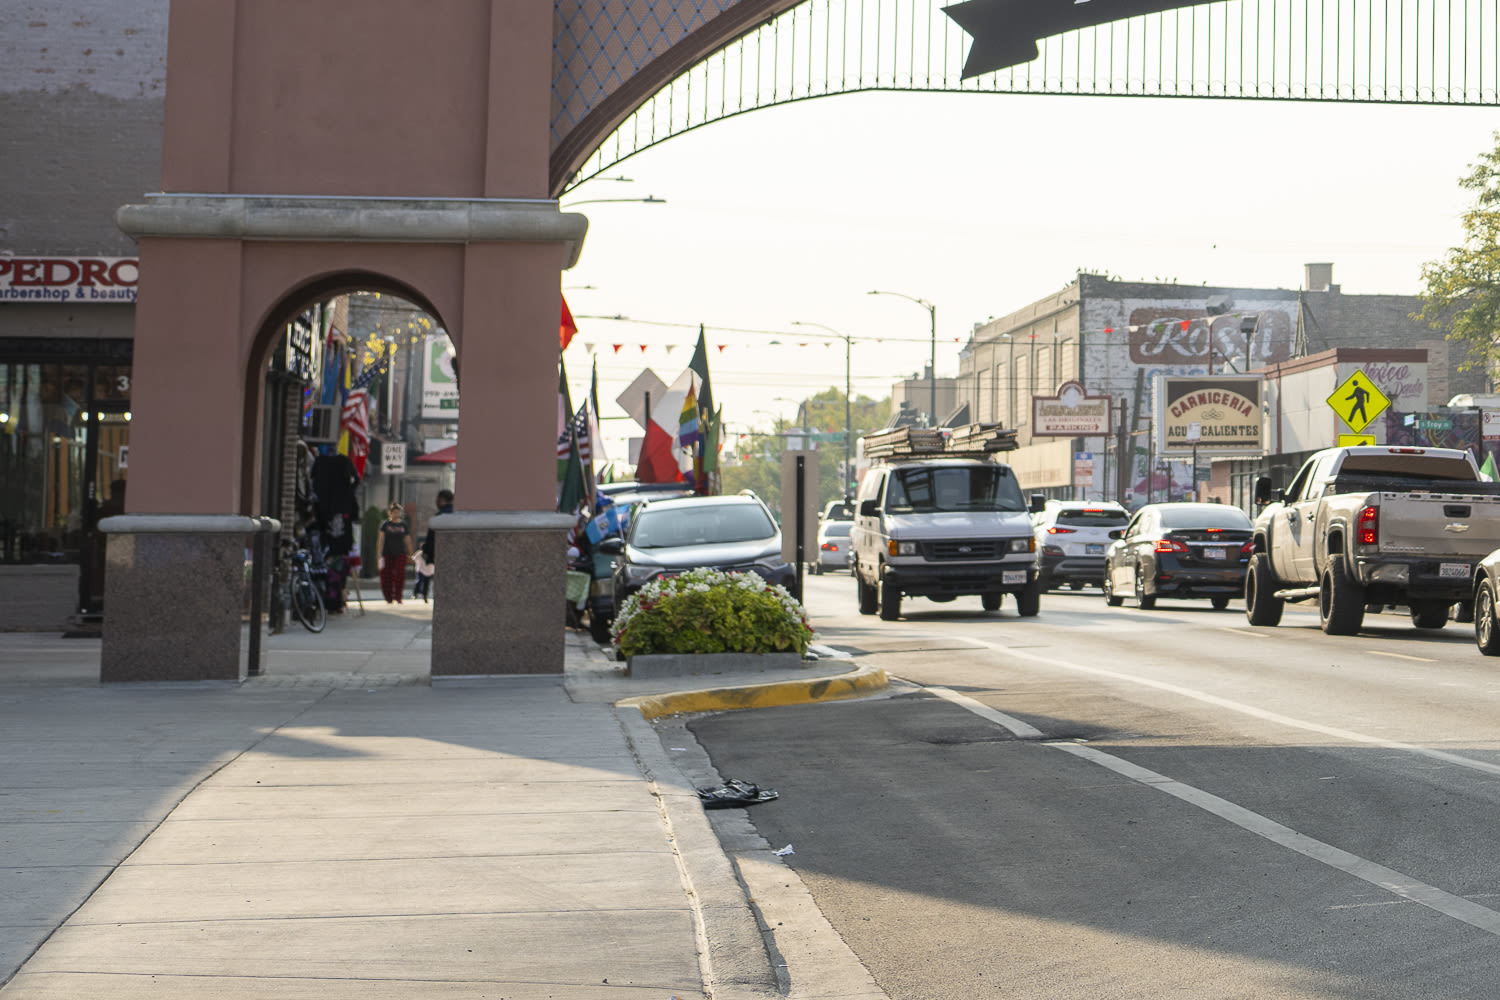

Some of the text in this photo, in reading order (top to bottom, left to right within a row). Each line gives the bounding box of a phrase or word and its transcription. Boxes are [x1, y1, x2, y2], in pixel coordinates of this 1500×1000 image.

[75, 286, 85, 299] &
[1170, 391, 1252, 418] CARNICERIA
[1168, 425, 1258, 437] AGUCALIENTES
